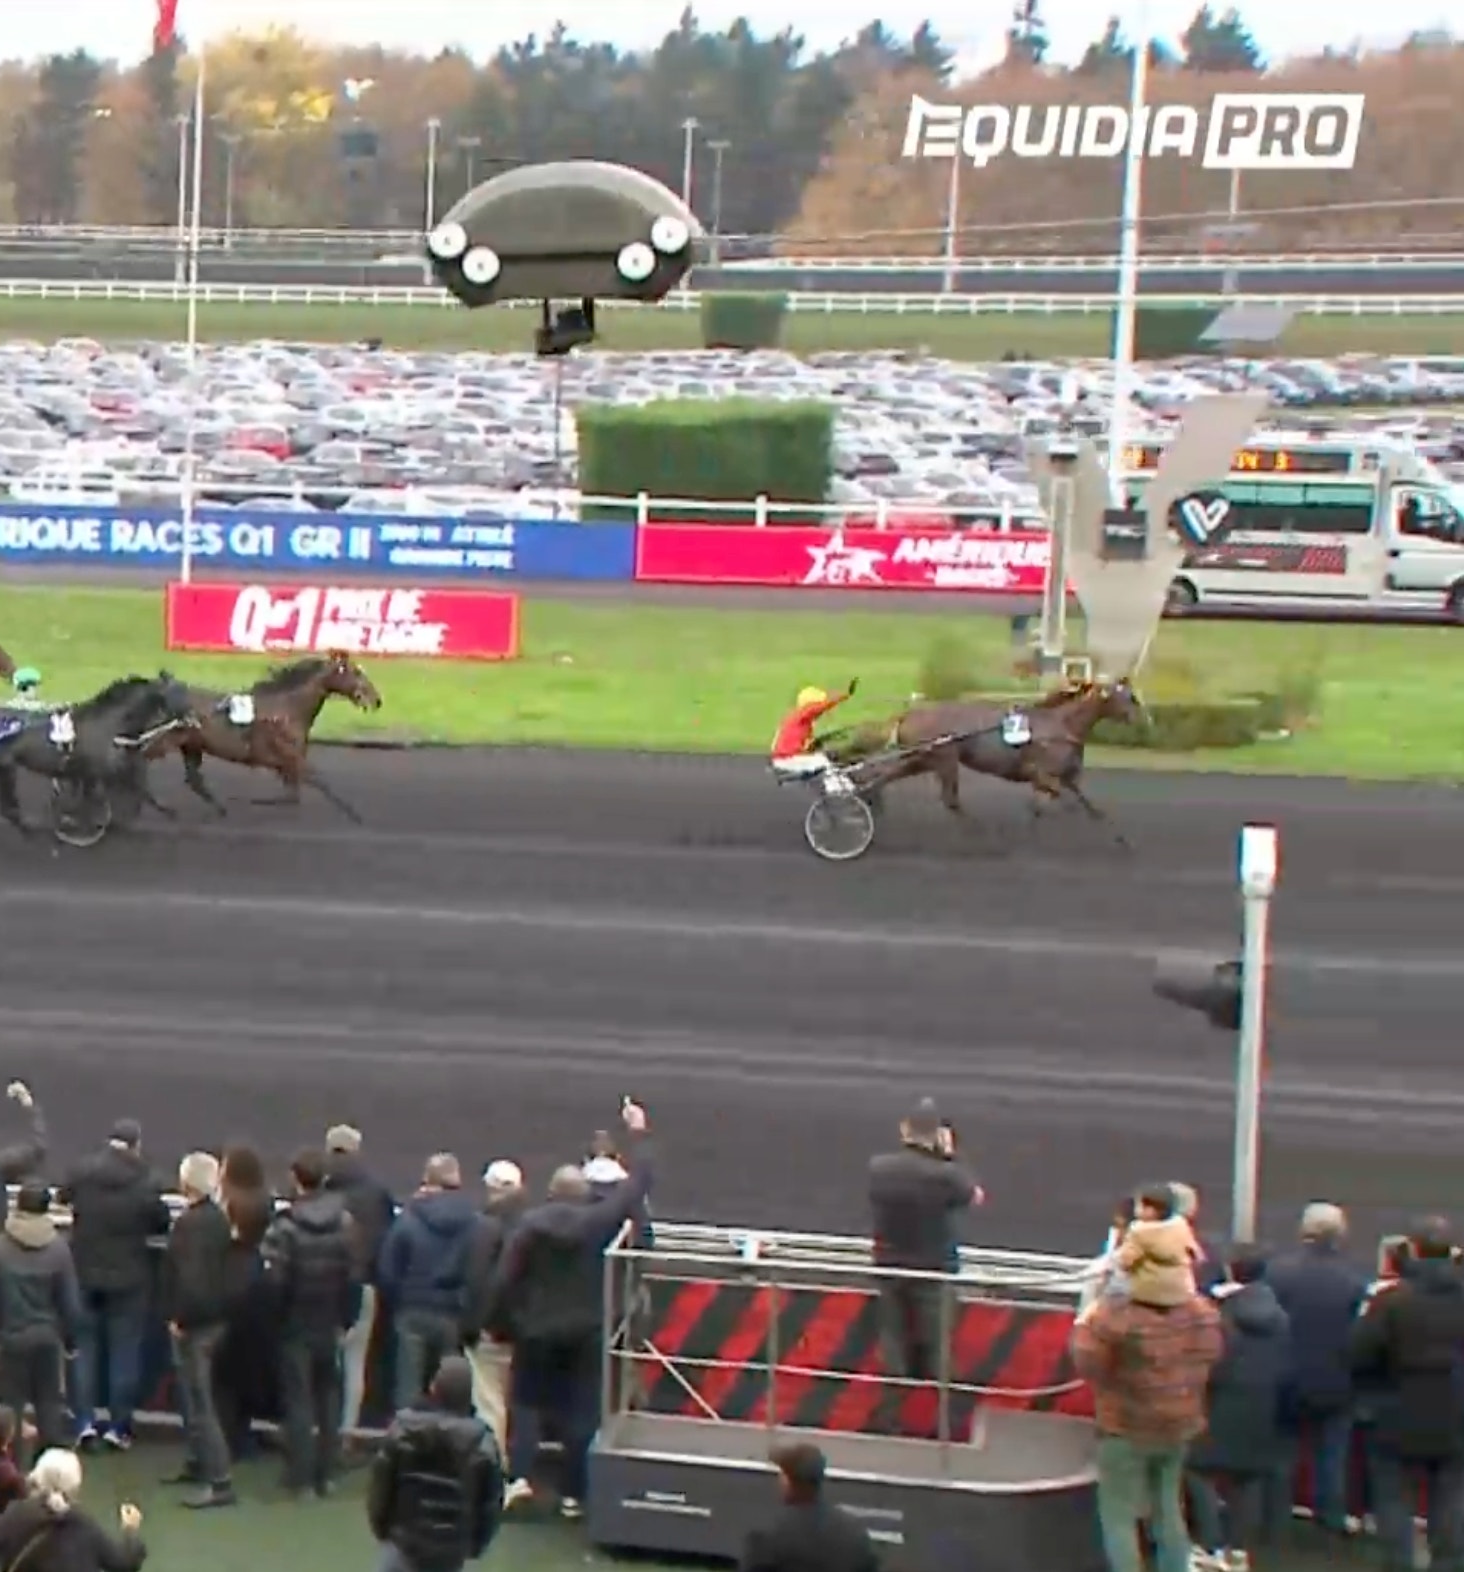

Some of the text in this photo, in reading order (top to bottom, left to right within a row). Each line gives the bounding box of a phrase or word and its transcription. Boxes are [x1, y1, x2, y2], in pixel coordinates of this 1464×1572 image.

[110, 519, 223, 555] RACES
[229, 522, 275, 557] Q1
[289, 525, 342, 559] GR
